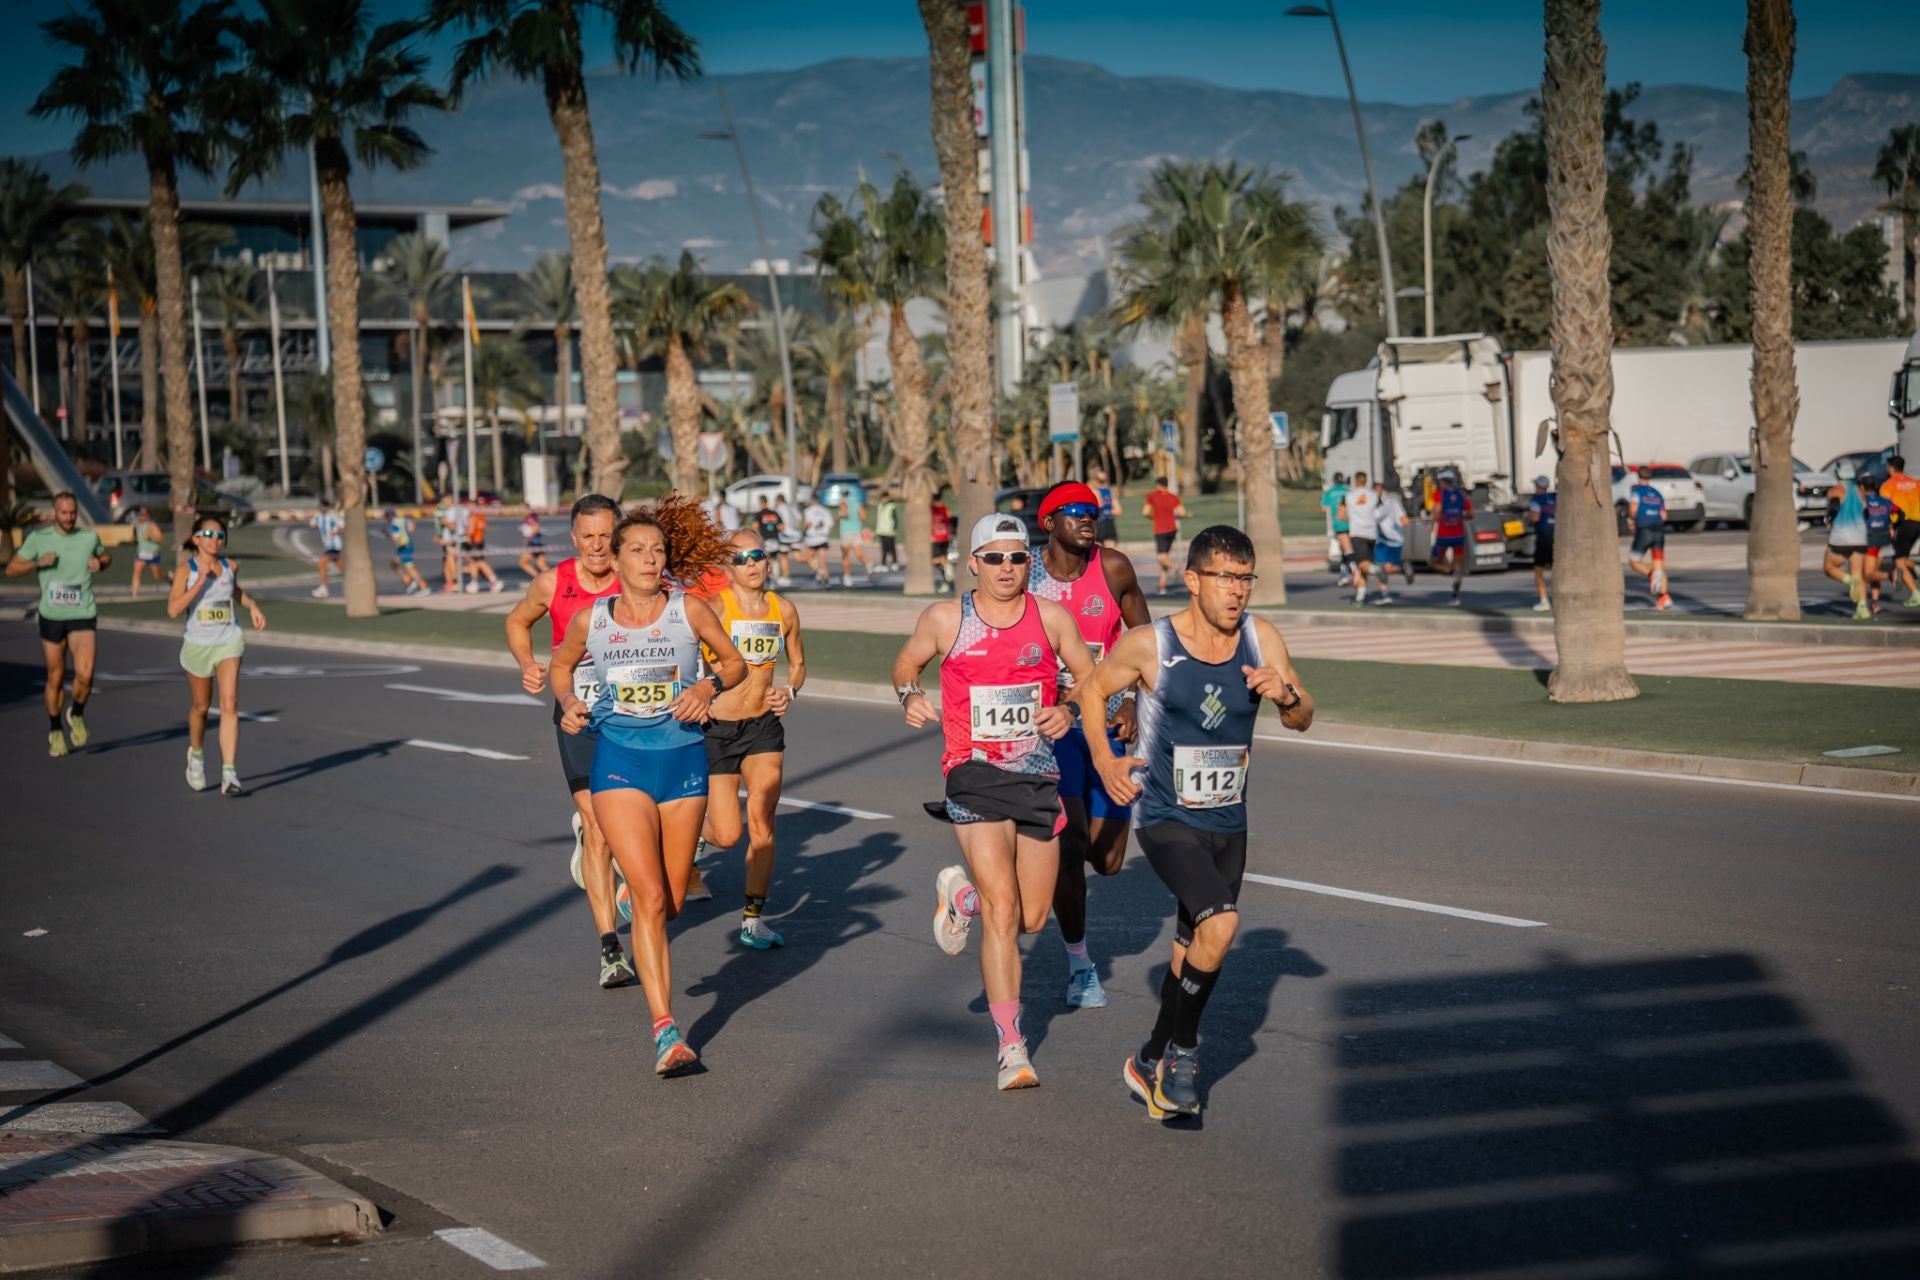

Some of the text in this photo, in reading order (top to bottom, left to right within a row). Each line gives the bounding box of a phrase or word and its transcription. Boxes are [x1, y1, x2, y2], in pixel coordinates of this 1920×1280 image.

[208, 610, 223, 620] 30
[743, 637, 775, 653] 187
[603, 647, 675, 661] MARACENA
[622, 684, 666, 704] 235
[986, 706, 1030, 727] 140
[1201, 749, 1229, 760] MEDIA
[1190, 770, 1236, 792] 112
